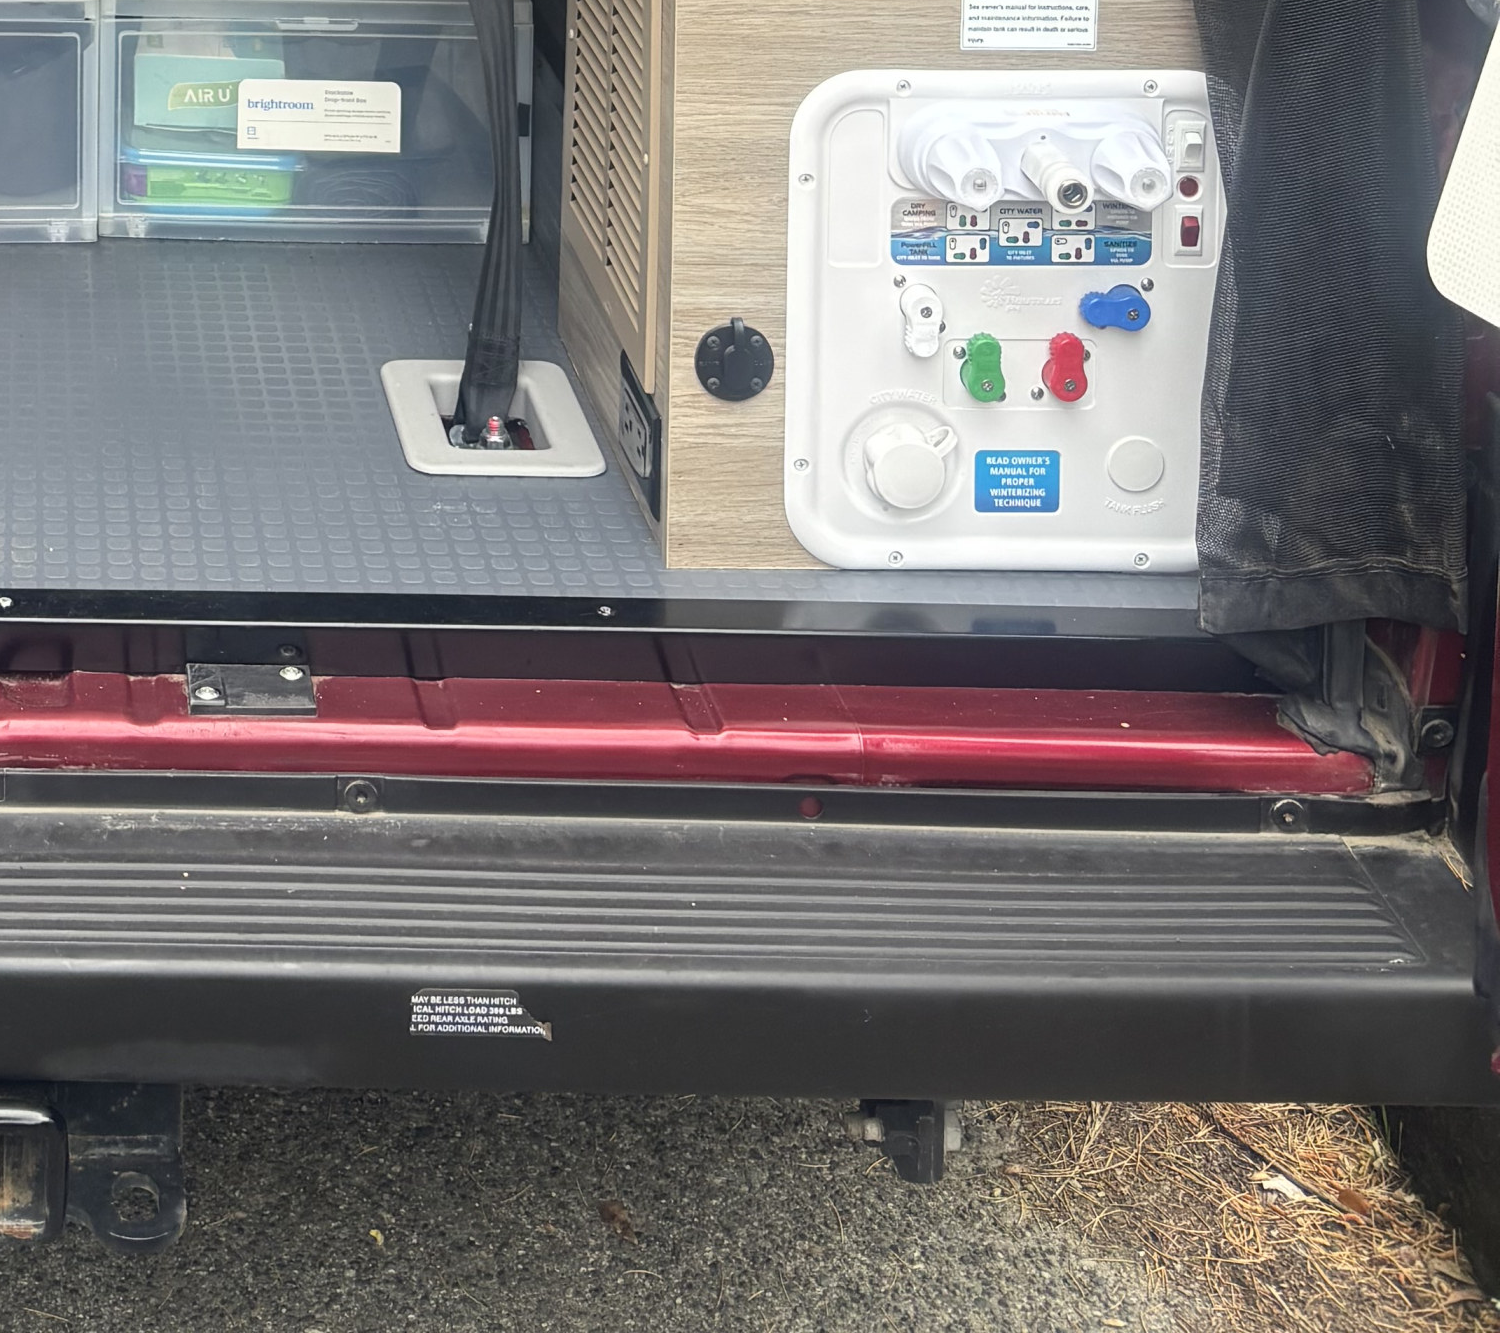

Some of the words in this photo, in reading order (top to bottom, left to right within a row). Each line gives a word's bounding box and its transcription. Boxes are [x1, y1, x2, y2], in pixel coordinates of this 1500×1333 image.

[183, 88, 215, 103] AIR
[247, 98, 314, 111] brightroom
[902, 209, 937, 217] CAMPING
[1016, 208, 1043, 216] WATER
[897, 388, 938, 405] WATER
[986, 456, 1010, 465] READ
[1011, 456, 1050, 465] OWNER'S
[989, 467, 1027, 475] MANUAL
[1029, 467, 1046, 475] FOR
[1001, 477, 1035, 486] PROPER
[989, 488, 1046, 496] WINTERIZING
[993, 498, 1042, 508] TECHNIQUE
[443, 996, 465, 1004] LESS
[466, 997, 490, 1005] THAN
[490, 997, 517, 1005] HITCH
[435, 1005, 462, 1013] HITCH
[463, 1006, 488, 1014] LOAD
[505, 1007, 523, 1015] LBS
[430, 1015, 453, 1023] REAR
[454, 1015, 476, 1023] AXLE
[477, 1016, 508, 1024] RATING
[418, 1024, 436, 1032] FOR
[436, 1024, 488, 1033] ADDITIONAL
